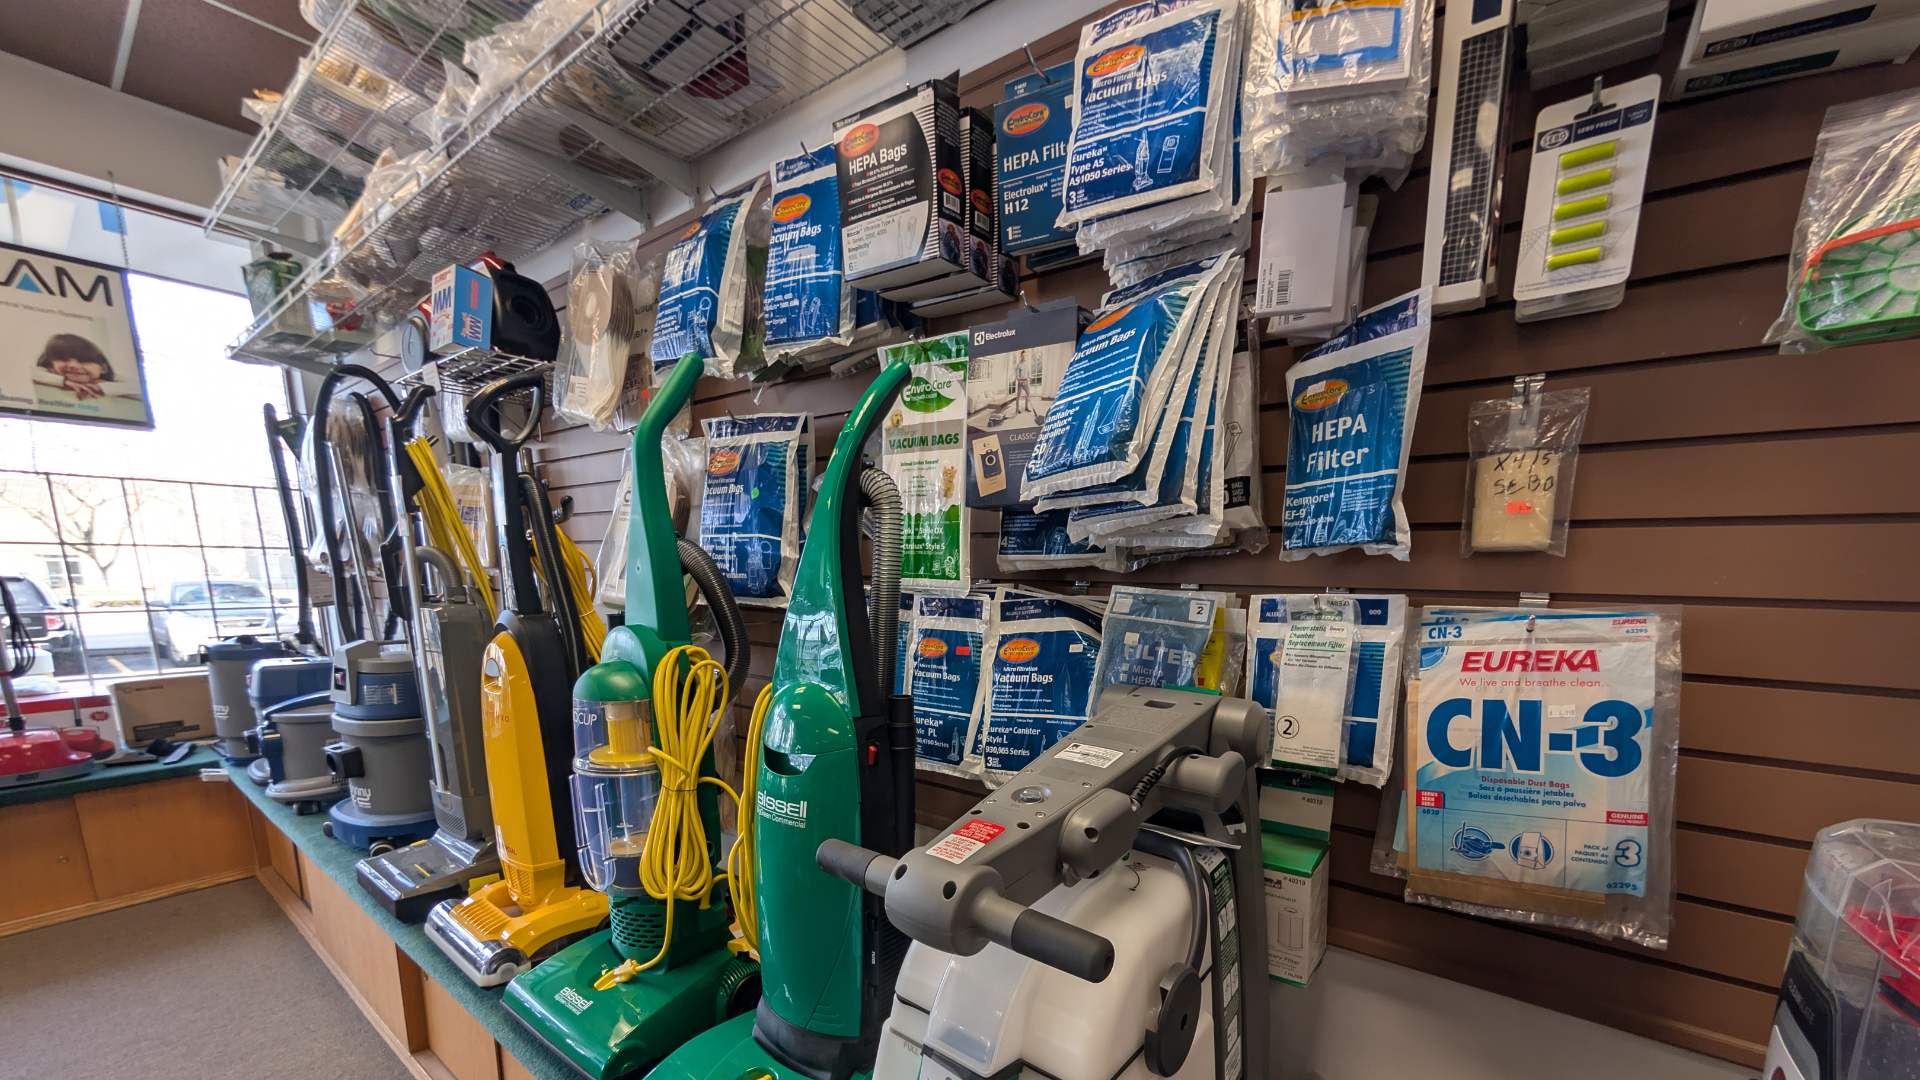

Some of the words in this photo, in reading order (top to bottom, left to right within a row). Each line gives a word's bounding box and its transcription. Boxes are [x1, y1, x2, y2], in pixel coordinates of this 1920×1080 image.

[1093, 51, 1138, 72] EnviroCare
[1113, 71, 1145, 83] Filtration
[1136, 71, 1168, 90] Bags
[1007, 109, 1044, 131] EnviroCare
[1577, 125, 1595, 135] SEBO
[1596, 118, 1619, 130] FRESH
[1542, 132, 1566, 147] SEBO
[849, 152, 877, 176] HEPA
[879, 144, 908, 163] Bags
[1003, 150, 1039, 173] HEPA
[1043, 141, 1067, 162] Filt
[1072, 148, 1103, 164] Eureka
[1071, 163, 1091, 175] Type
[1092, 158, 1105, 168] AS
[1069, 171, 1100, 187] AS1050
[1102, 164, 1131, 178] Series
[1003, 184, 1045, 201] Electrolux
[1069, 191, 1077, 204] 3
[1004, 198, 1029, 215] H12
[881, 219, 891, 228] Type
[770, 230, 799, 244] acuum
[800, 224, 822, 237] Bags
[1006, 226, 1012, 240] 1
[848, 262, 854, 272] 6
[0, 258, 113, 307] AM
[985, 329, 1016, 340] Electrolux
[1096, 328, 1122, 341] Filtration
[1109, 328, 1136, 346] Bags
[903, 380, 952, 402] EnviroCare
[1047, 408, 1075, 423] anitaire
[1037, 428, 1066, 441] Duralite
[1312, 413, 1367, 443] HEPA
[888, 435, 928, 450] VACUUM
[931, 432, 959, 447] BAGS
[1009, 432, 1037, 441] CLASSIC
[1032, 443, 1046, 457] SD
[1306, 446, 1369, 474] Filter
[728, 484, 744, 495] Bags
[1231, 488, 1243, 496] SACS
[1286, 494, 1329, 507] Kenmore
[1285, 509, 1306, 520] EF-9
[925, 543, 940, 551] Style
[1000, 536, 1008, 547] 4
[1284, 540, 1290, 550] 1
[1196, 606, 1204, 616] 2
[1428, 626, 1462, 640] CN-3
[1612, 618, 1648, 626] EUREKA
[1004, 646, 1035, 655] EnviroCare
[1287, 640, 1327, 648] Replacement
[1328, 640, 1346, 649] Filter
[1125, 643, 1197, 668] FILTER
[1461, 650, 1600, 673] EUREKA
[914, 669, 942, 679] Vacuum
[942, 672, 961, 682] Bags
[1132, 665, 1164, 677] Micron
[994, 672, 1029, 683] Vacuum
[1031, 672, 1053, 685] Bags
[1460, 678, 1477, 687] We
[1480, 677, 1497, 687] live
[1501, 677, 1521, 687] and
[1525, 677, 1566, 687] breathe
[1570, 677, 1605, 687] clean.
[928, 728, 938, 738] PL
[1013, 726, 1041, 736] Canister
[1282, 718, 1293, 736] 2
[935, 739, 949, 748] Series
[985, 735, 1002, 745] Style
[1003, 735, 1008, 744] L
[1426, 698, 1642, 778] CN-3
[985, 745, 1009, 756] 930,965
[1009, 746, 1030, 757] Series
[986, 756, 993, 767] 3
[1481, 775, 1526, 787] Disposable
[1527, 778, 1547, 787] Dust
[1550, 780, 1571, 790] Bags
[1478, 784, 1497, 792] Sacs
[1505, 786, 1541, 797] poussière
[1542, 788, 1575, 798] jetables
[1306, 797, 1323, 806] 40319
[1468, 791, 1491, 801] Bolsas
[1494, 793, 1539, 804] desechables
[1542, 797, 1561, 806] para
[1563, 799, 1587, 809] polvo
[1422, 808, 1440, 816] 6820
[772, 813, 806, 829] Commercial
[1614, 839, 1642, 868] 3
[1571, 857, 1608, 865] CONTENIDO
[1288, 877, 1306, 886] 40319
[1606, 882, 1637, 891] 62295
[1264, 890, 1297, 903] placement
[1284, 956, 1300, 966] Filter
[1287, 972, 1303, 980] FILTER
[903, 1041, 919, 1056] FULL
